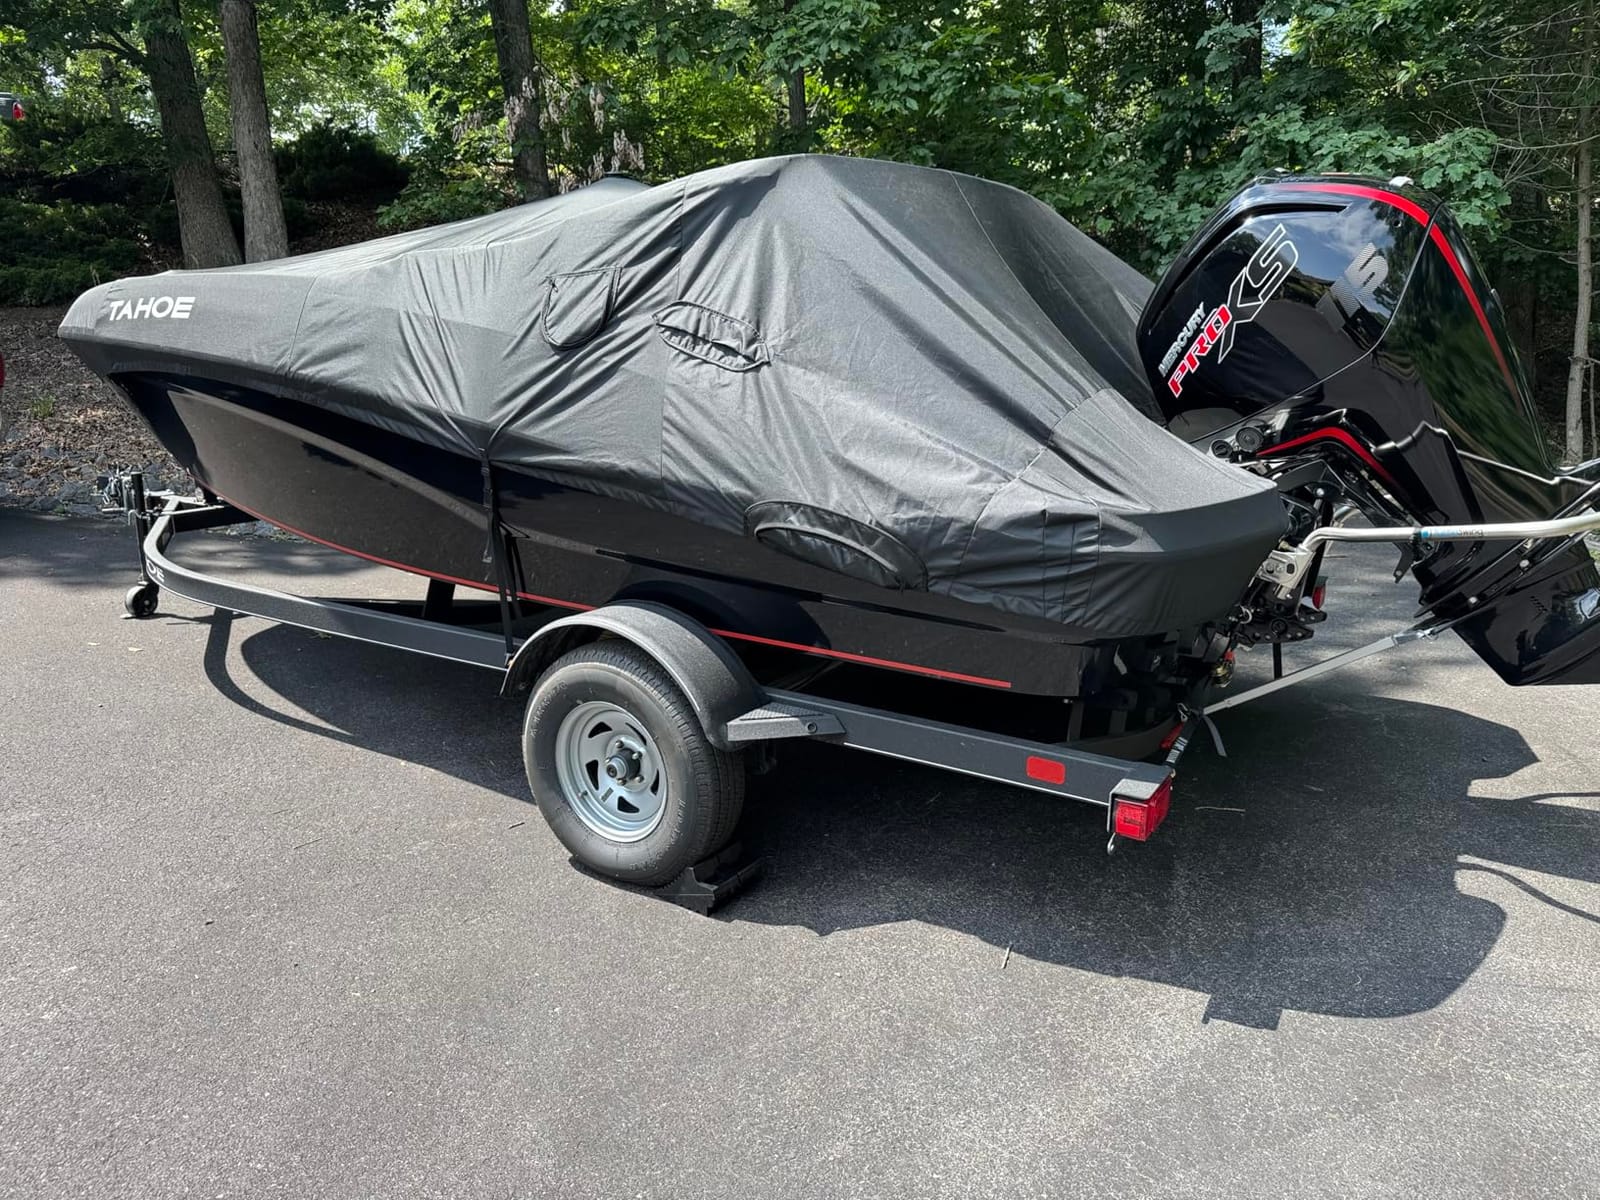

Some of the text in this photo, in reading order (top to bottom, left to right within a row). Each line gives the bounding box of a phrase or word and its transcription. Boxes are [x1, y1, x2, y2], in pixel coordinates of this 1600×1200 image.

[109, 296, 196, 321] TAHOE
[1158, 301, 1206, 378] MERCURY
[1168, 223, 1299, 398] PRO XS
